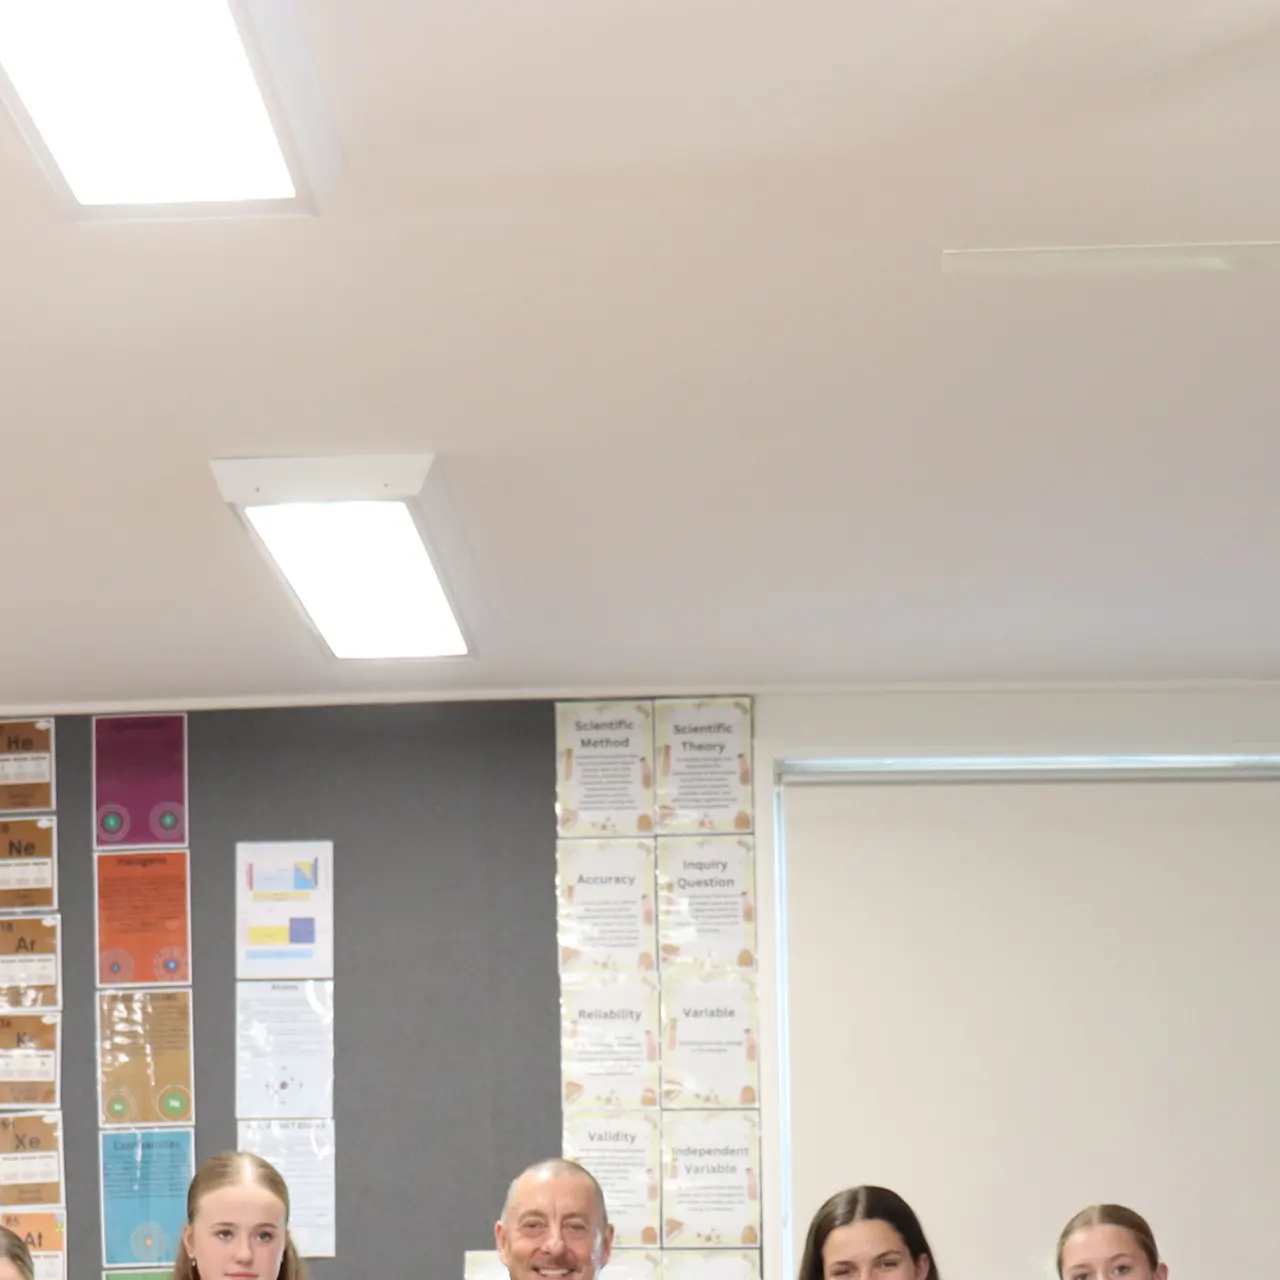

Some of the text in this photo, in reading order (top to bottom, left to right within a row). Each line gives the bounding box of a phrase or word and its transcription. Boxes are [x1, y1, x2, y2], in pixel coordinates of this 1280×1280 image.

[574, 719, 635, 732] Scientific
[672, 723, 734, 736] Scientific
[6, 735, 34, 752] He
[580, 736, 631, 749] Method
[681, 741, 726, 754] Theory
[7, 839, 37, 857] Ne
[682, 859, 729, 873] Inquiry
[576, 874, 637, 887] Accuracy
[676, 877, 735, 890] Question
[14, 936, 38, 953] Ar
[577, 1009, 643, 1023] Reliability
[682, 1006, 736, 1019] Variable
[14, 1132, 42, 1151] Xe
[587, 1131, 637, 1146] Validity
[671, 1146, 750, 1159] Independent
[684, 1162, 738, 1175] Variable
[23, 1231, 44, 1249] At
